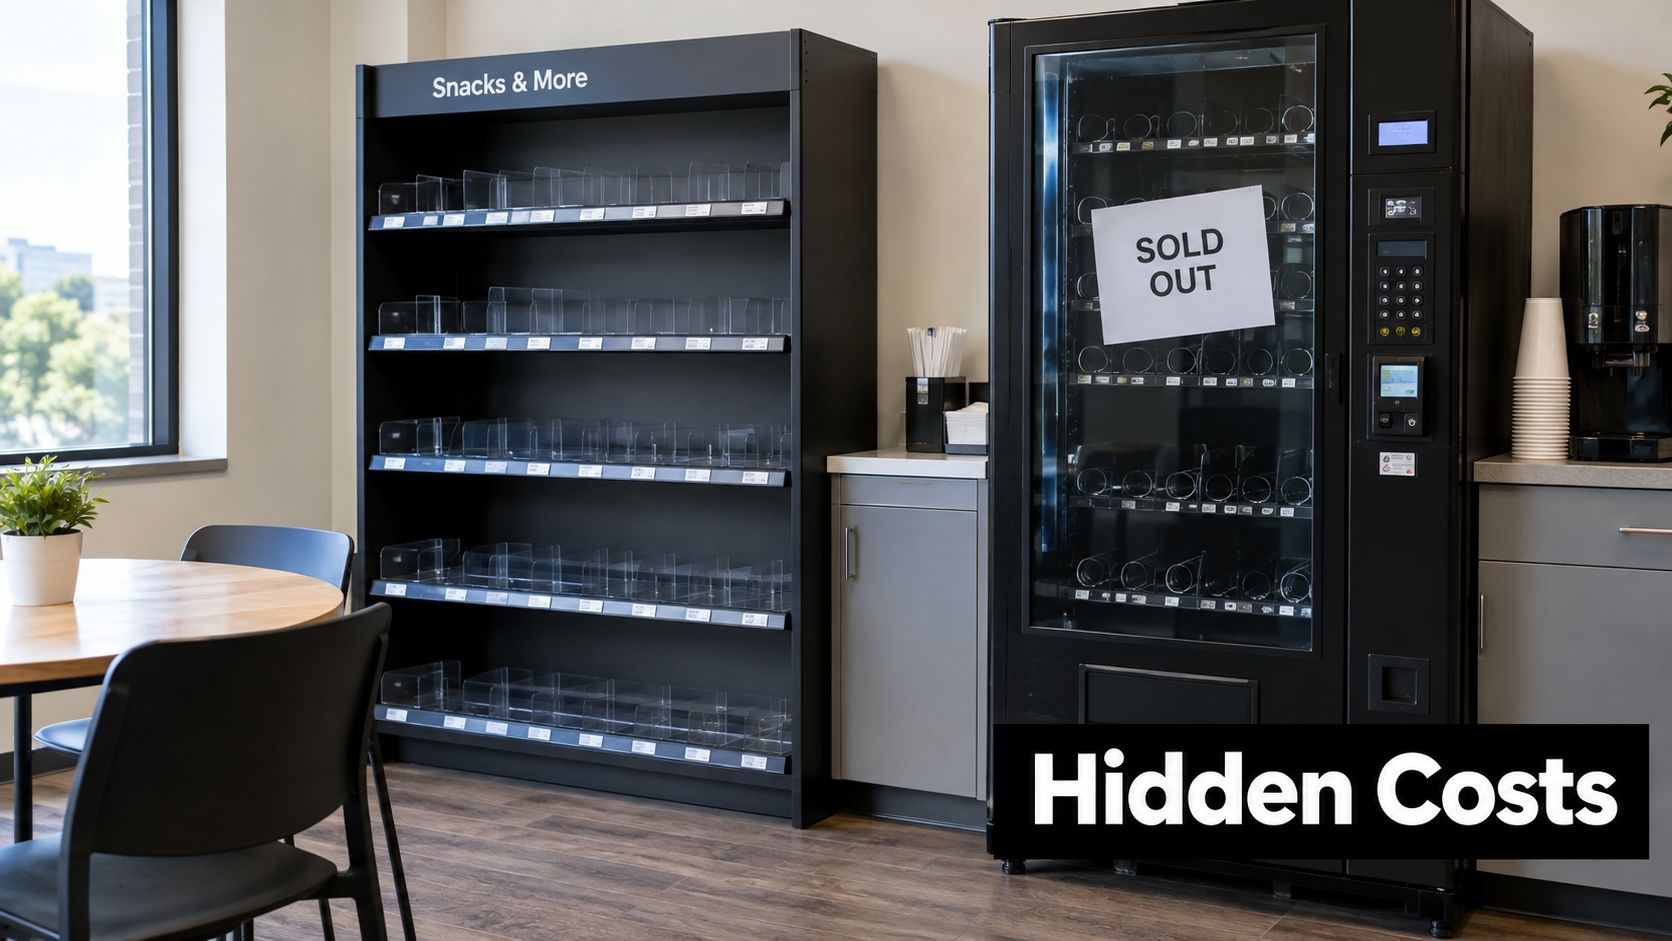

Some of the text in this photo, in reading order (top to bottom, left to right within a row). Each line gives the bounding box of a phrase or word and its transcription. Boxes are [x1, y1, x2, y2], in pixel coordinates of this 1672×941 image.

[432, 69, 589, 99] Snacks & More
[1136, 228, 1224, 264] SOLD
[1150, 264, 1217, 298] OUT
